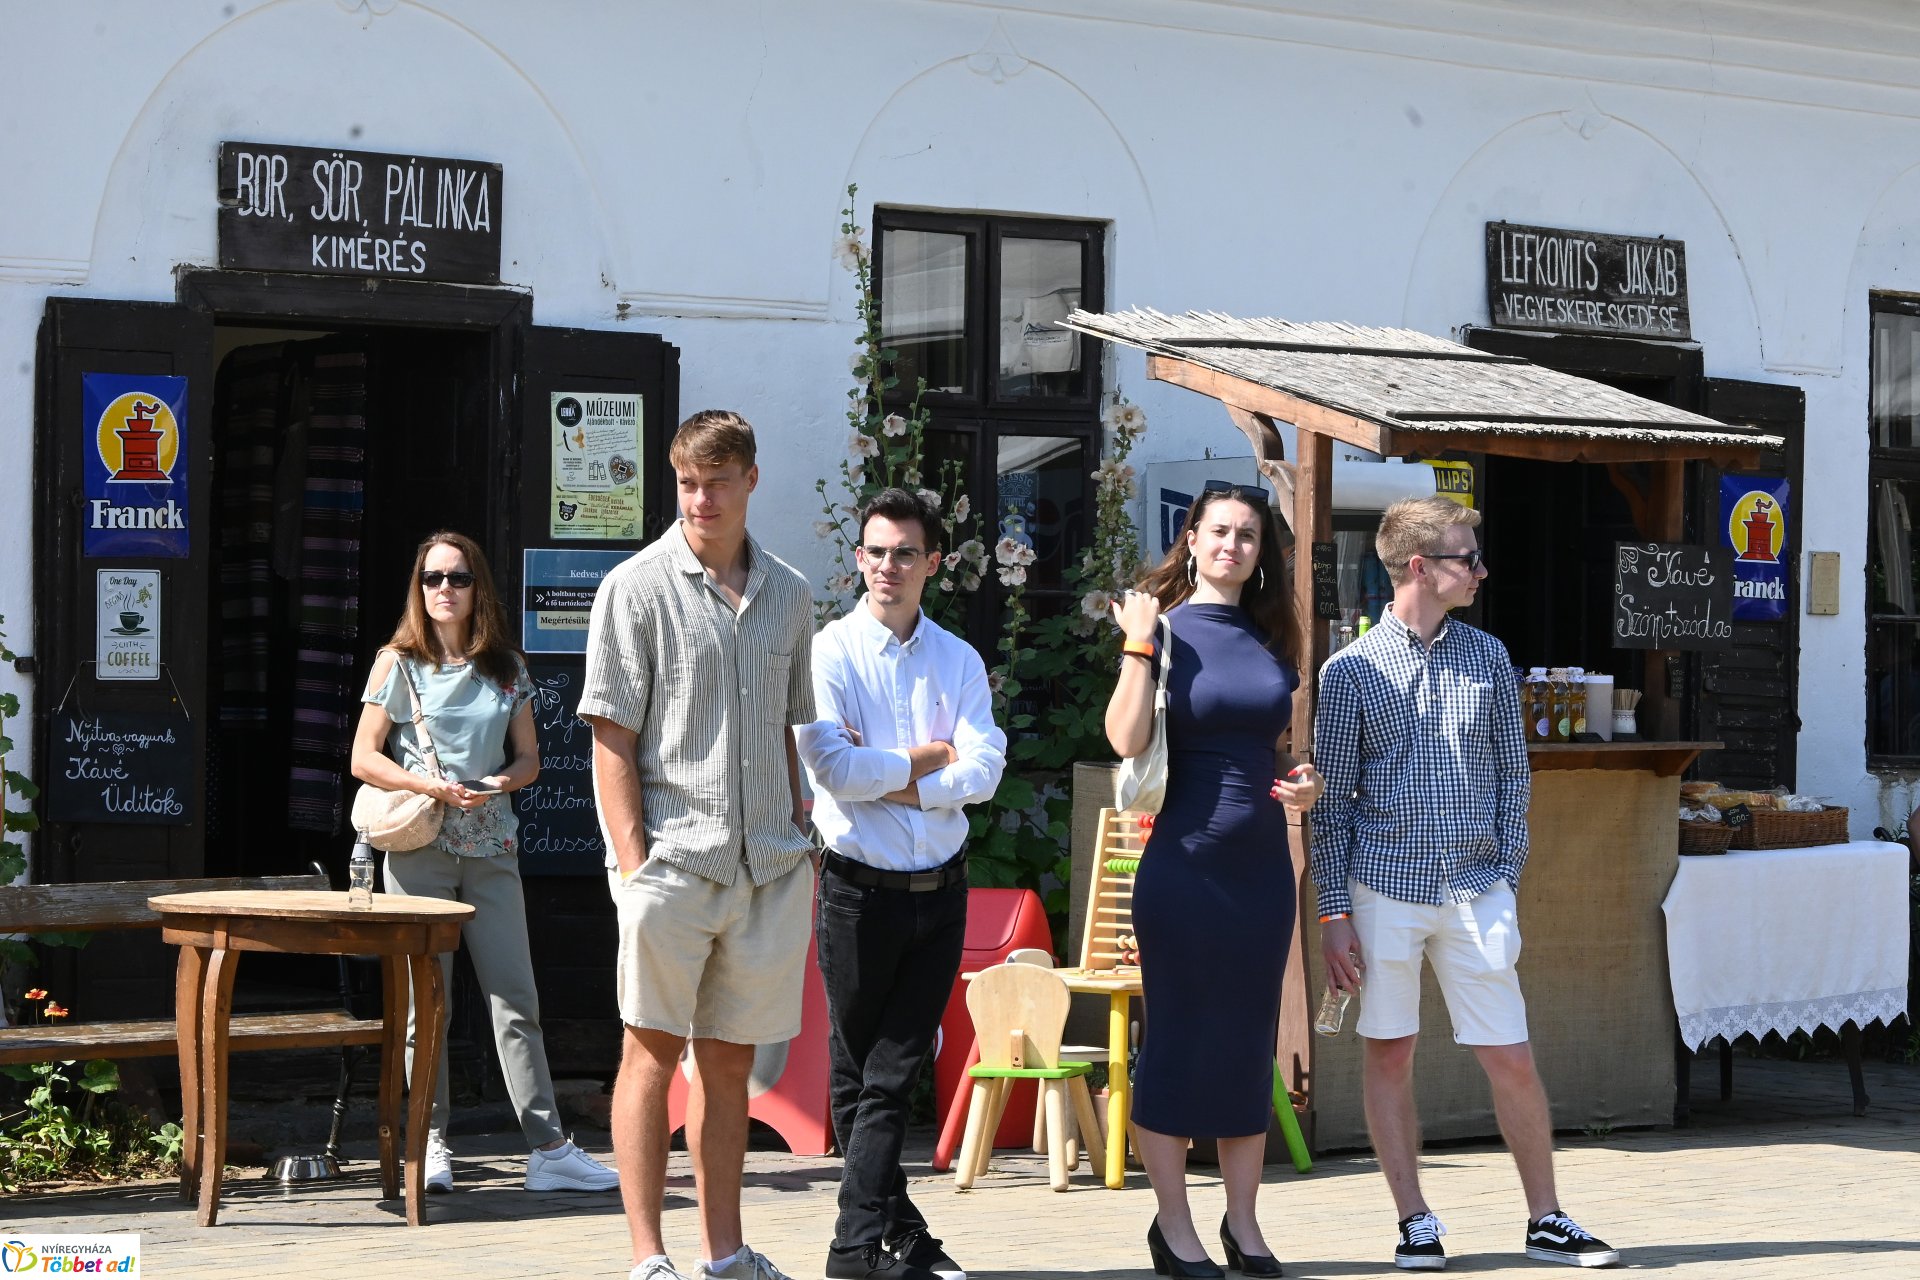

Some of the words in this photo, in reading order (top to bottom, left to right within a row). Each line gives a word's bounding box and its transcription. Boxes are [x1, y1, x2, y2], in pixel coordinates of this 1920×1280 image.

[236, 152, 294, 223] BOR,
[311, 152, 368, 228] SÖR,
[385, 157, 491, 234] PÁLINKA
[311, 231, 427, 274] KIMÉRÉS
[1500, 230, 1599, 291] LEFKOVITS
[1618, 244, 1678, 296] JAKAB
[1502, 292, 1681, 333] VEGYESKERESKEDÉSE
[586, 397, 636, 417] MÚZEUMI
[89, 499, 186, 530] Franck
[109, 576, 121, 585] One
[123, 576, 138, 587] Day
[570, 570, 598, 578] Kedves
[1648, 551, 1716, 588] Kávé
[1733, 576, 1786, 600] ranck
[107, 651, 151, 667] COFFEE
[65, 717, 121, 752] Nyitva
[122, 728, 176, 749] vagyunk
[65, 757, 129, 780] Kávé
